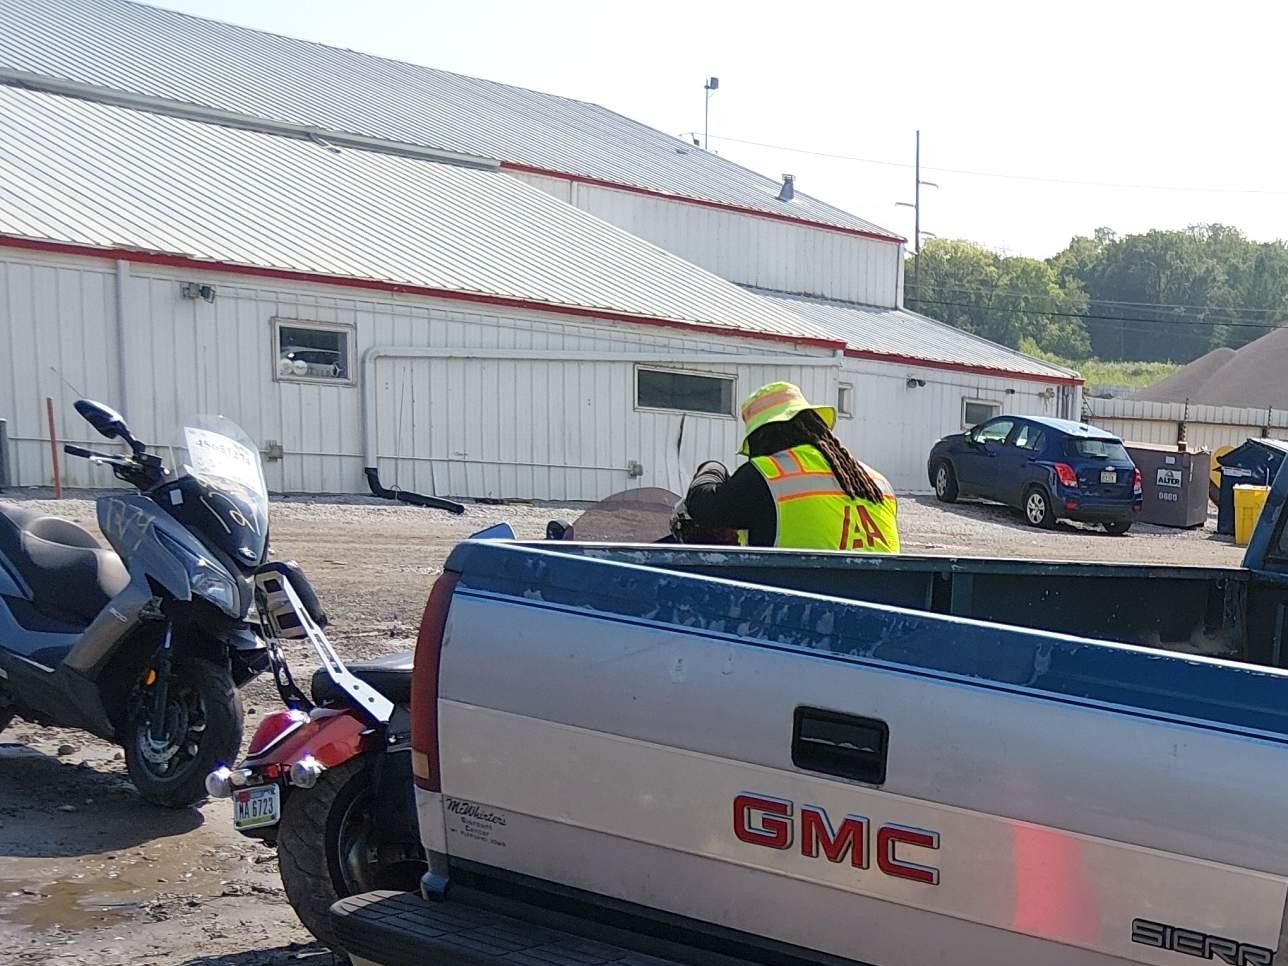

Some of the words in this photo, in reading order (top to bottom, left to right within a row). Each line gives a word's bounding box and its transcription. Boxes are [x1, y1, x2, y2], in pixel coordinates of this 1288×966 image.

[1158, 476, 1180, 486] ALTER
[252, 796, 274, 818] 6723
[733, 791, 941, 887] GMC
